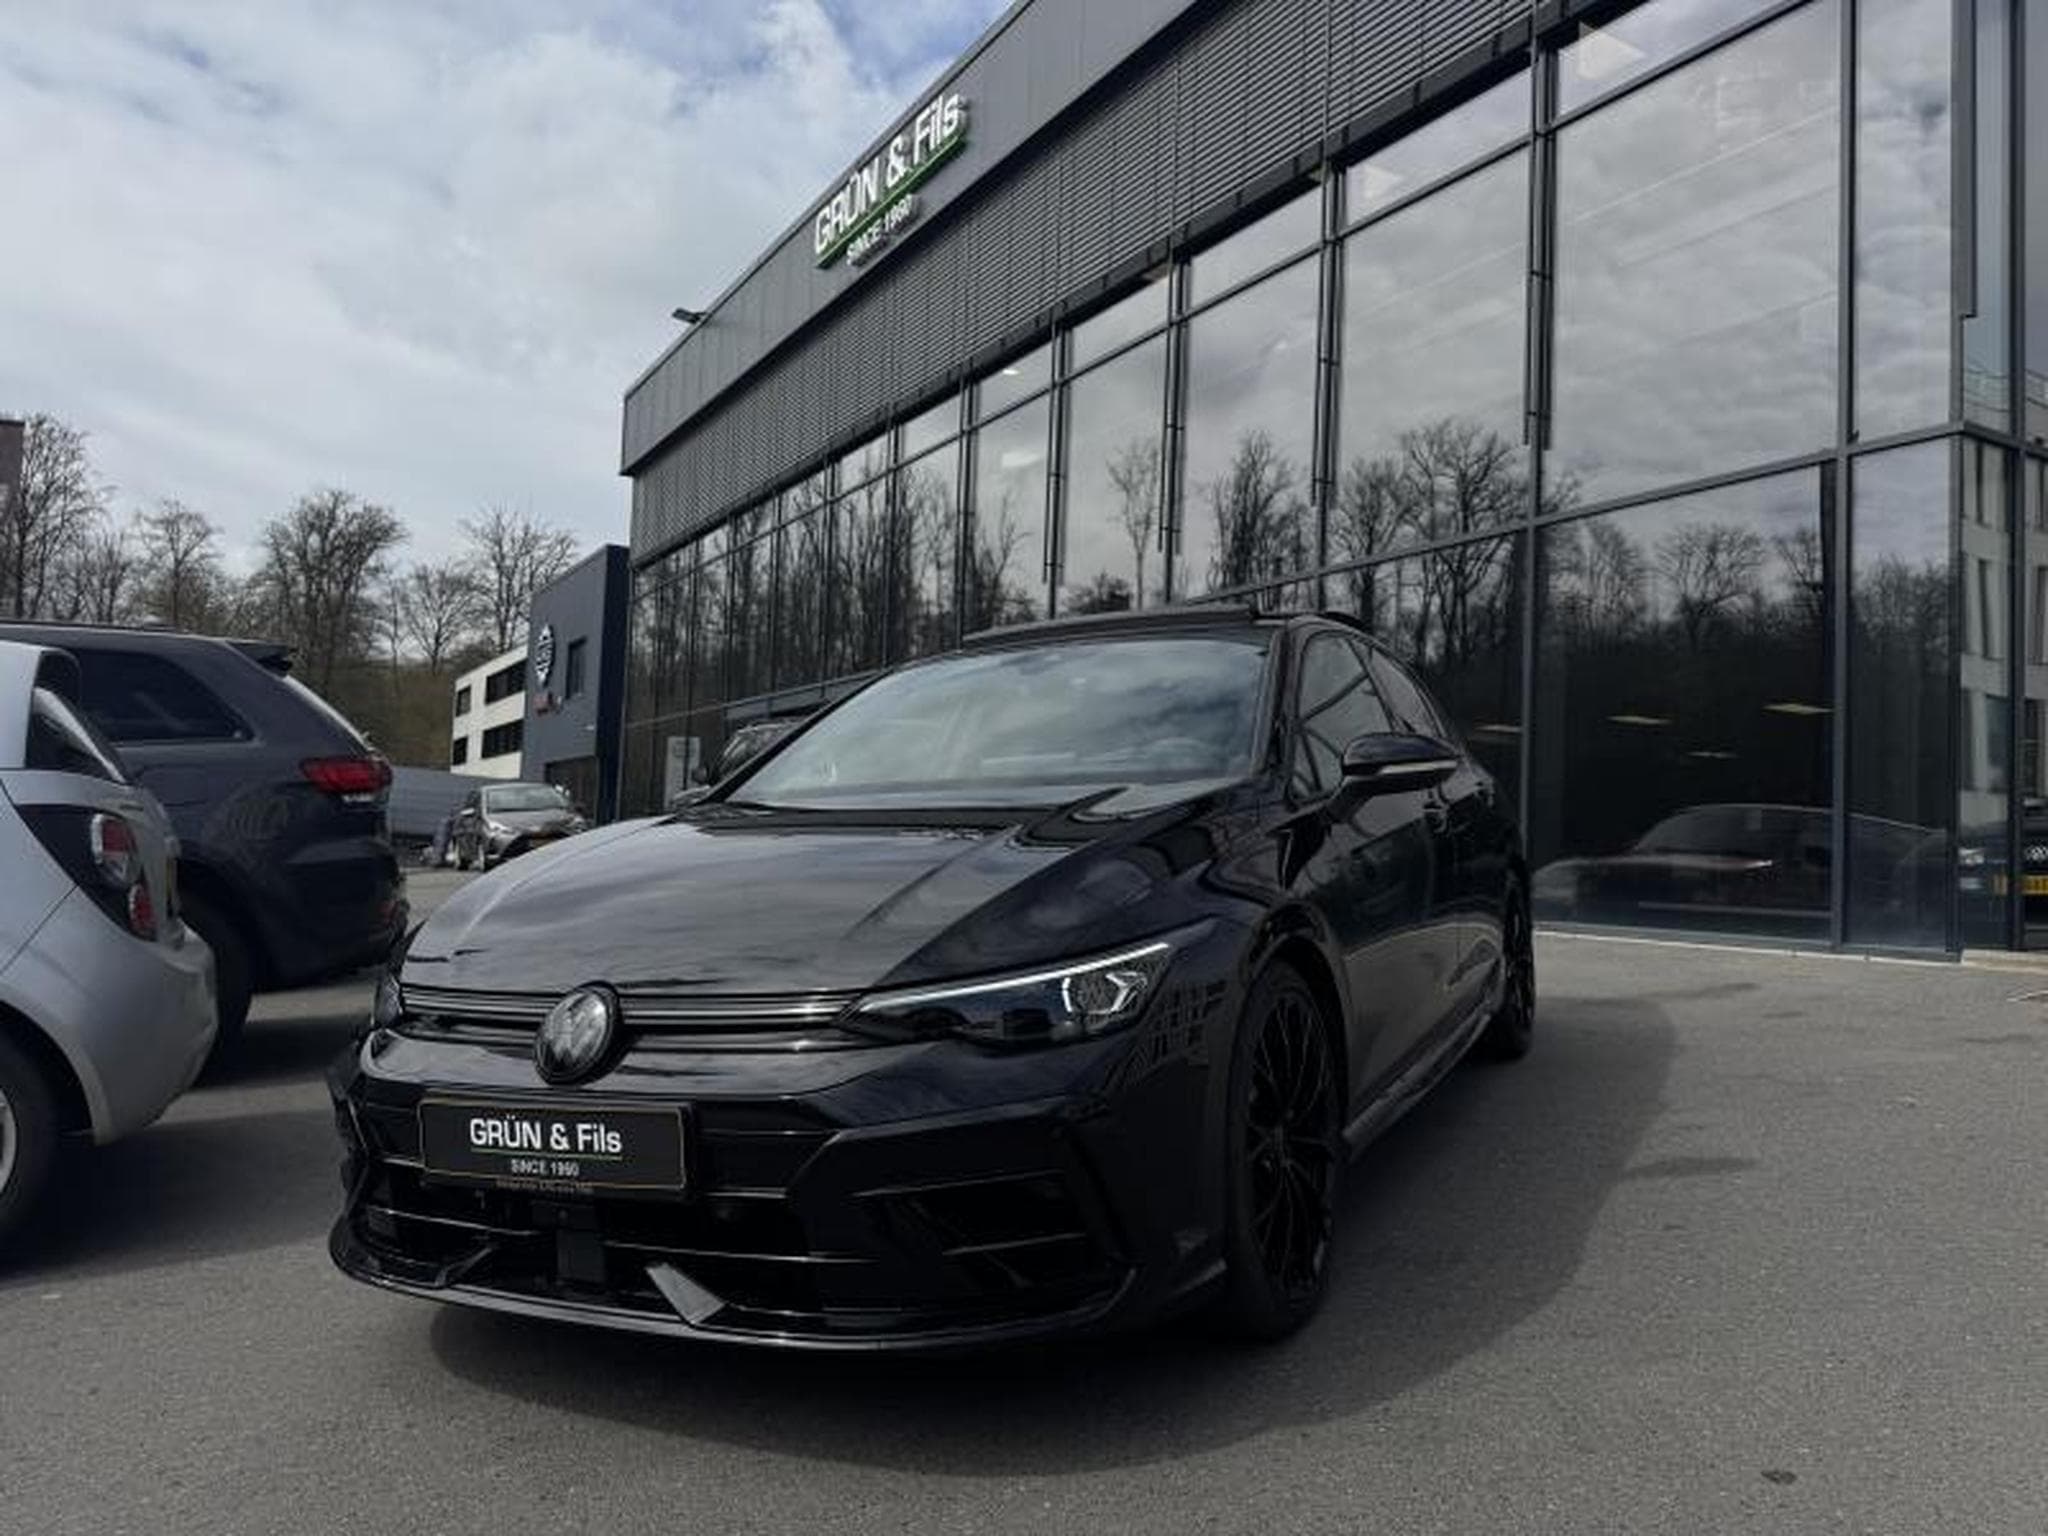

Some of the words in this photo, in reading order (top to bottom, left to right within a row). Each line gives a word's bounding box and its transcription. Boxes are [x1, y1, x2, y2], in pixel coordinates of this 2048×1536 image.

[814, 157, 880, 255] GRÜN
[886, 134, 911, 188] &
[913, 94, 961, 165] Fils
[846, 219, 882, 266] SINCE
[469, 1114, 542, 1150] GRÜN
[549, 1122, 571, 1151] &
[576, 1122, 623, 1154] Fils
[510, 1159, 547, 1175] SINCE
